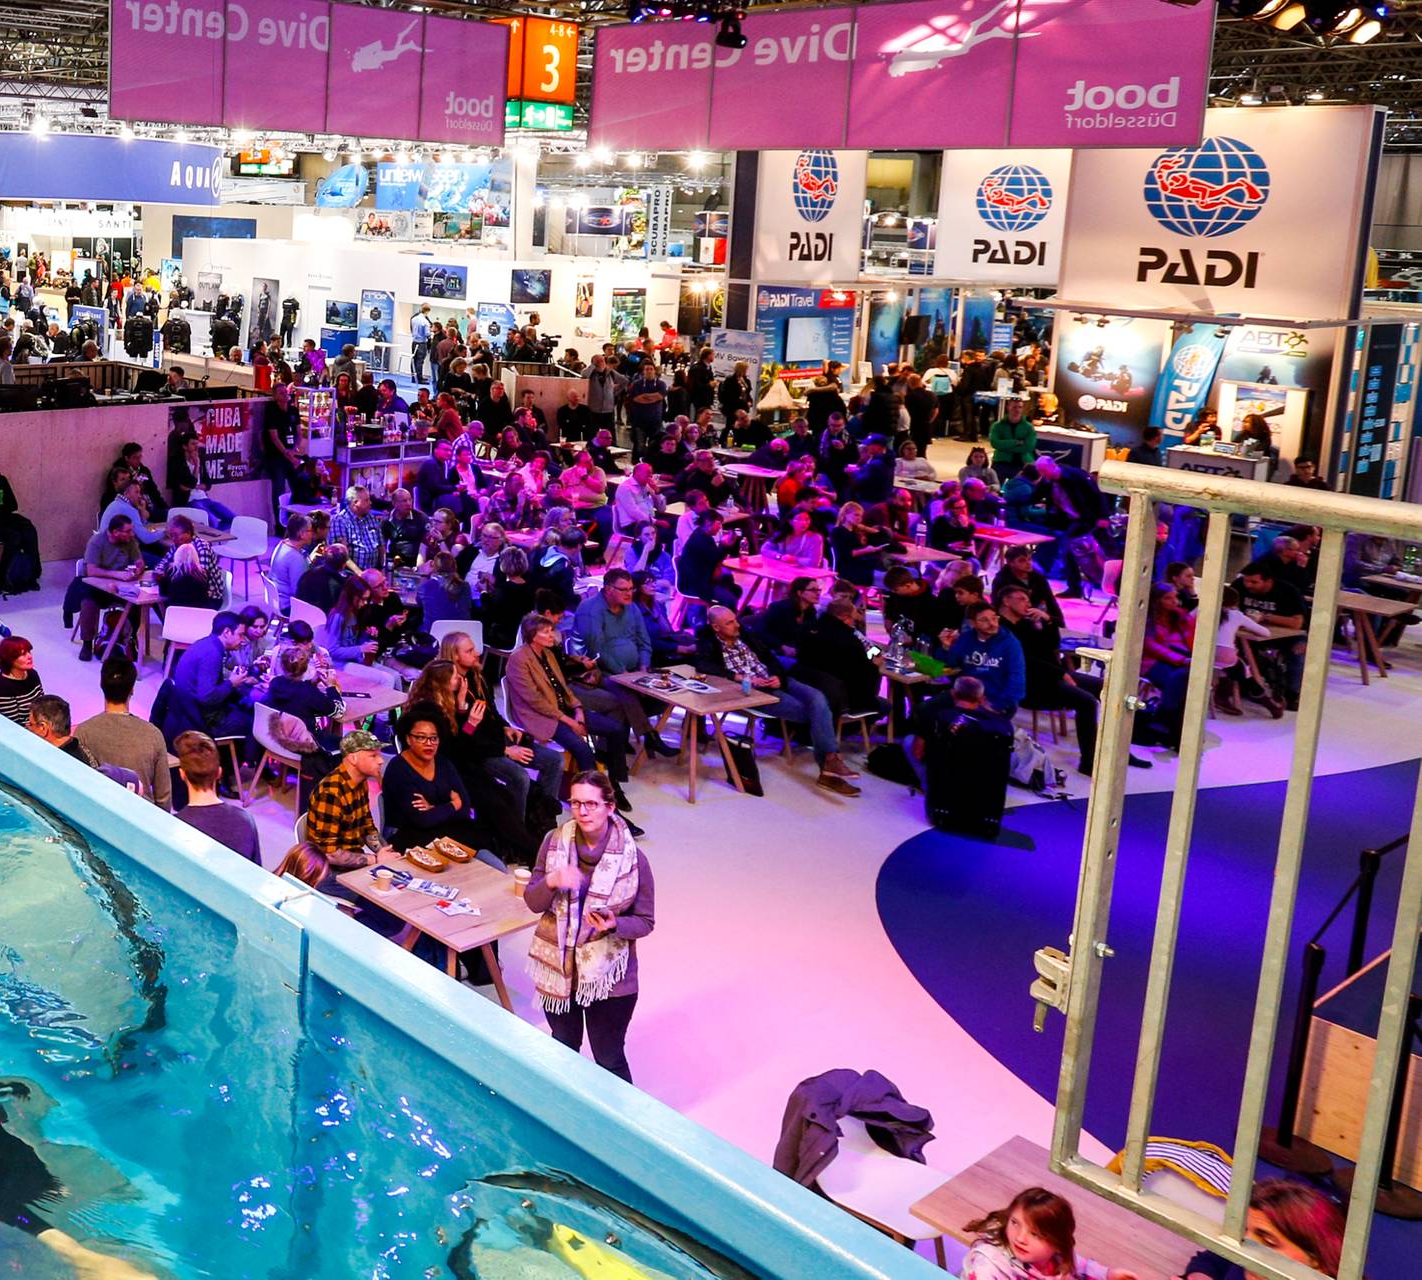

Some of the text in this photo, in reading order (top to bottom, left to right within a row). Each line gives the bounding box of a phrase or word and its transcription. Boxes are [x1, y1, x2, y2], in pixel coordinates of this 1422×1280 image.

[549, 23, 564, 37] 4-8
[540, 44, 560, 93] 3
[170, 161, 210, 189] AQUA
[98, 219, 132, 229] SANTI
[650, 188, 661, 256] SCUBAPRO
[789, 231, 833, 262] PADI
[972, 239, 1047, 266] PADI
[1136, 247, 1259, 289] PADI
[769, 294, 790, 308] PADI
[790, 292, 815, 308] Travel
[1240, 330, 1290, 348] ABT
[727, 353, 758, 365] Bavaria
[1095, 400, 1130, 413] PADI
[1162, 380, 1205, 437] PADI
[206, 407, 241, 428] CUBA
[205, 432, 243, 454] MADE
[205, 460, 226, 479] ME
